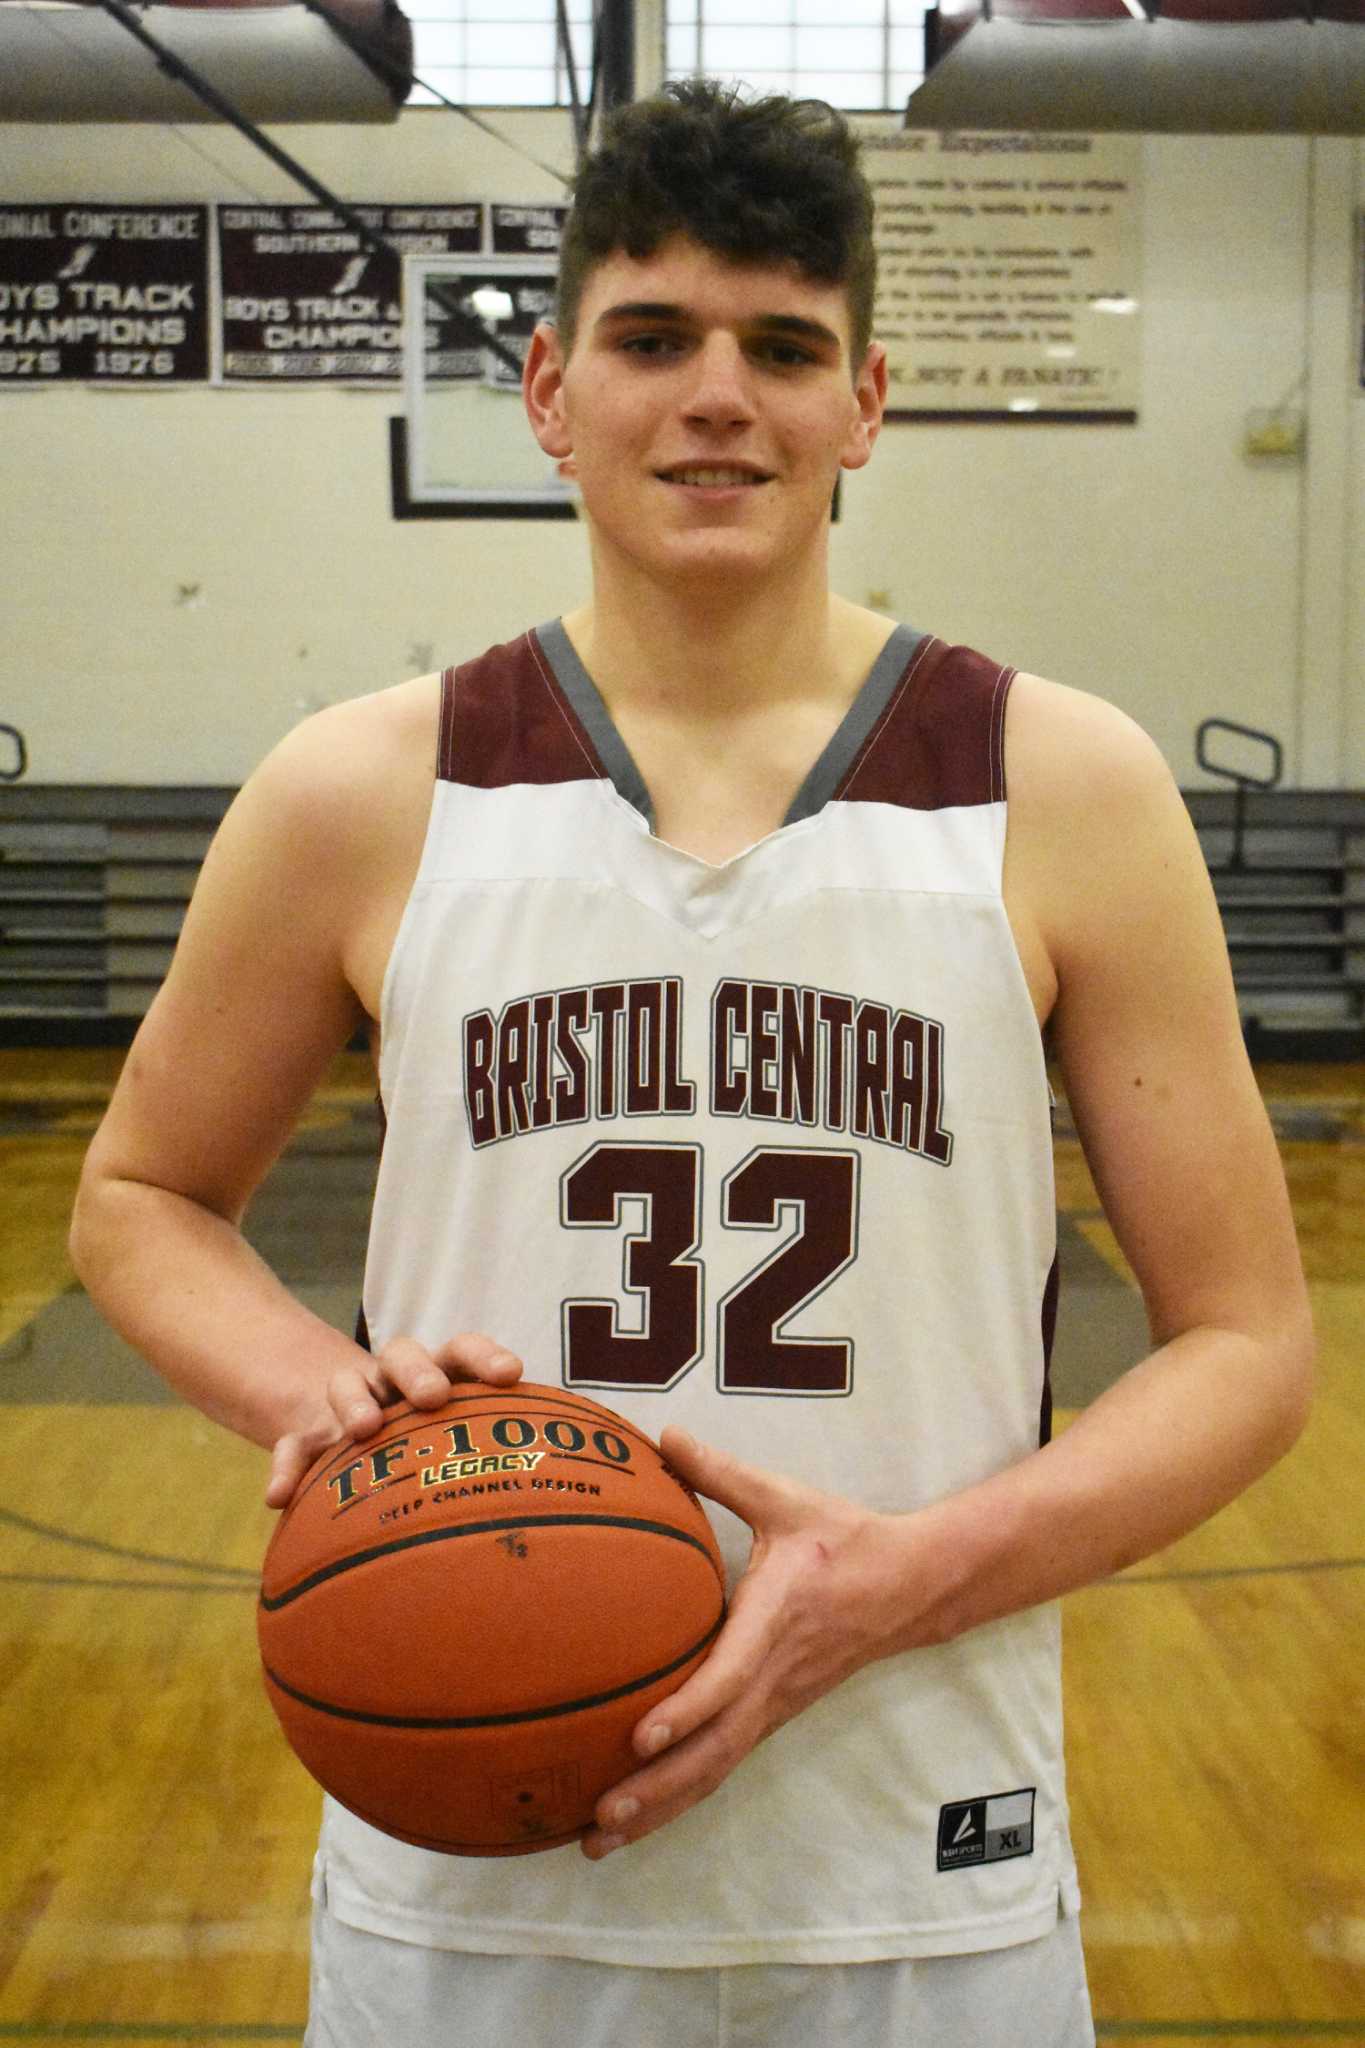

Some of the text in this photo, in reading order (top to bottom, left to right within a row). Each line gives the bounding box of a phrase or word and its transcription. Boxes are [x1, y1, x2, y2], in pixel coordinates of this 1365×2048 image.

[63, 211, 199, 239] CONFERENCE
[68, 283, 195, 311] TRACK
[294, 296, 379, 320] TRACK
[264, 325, 440, 349] CHAMPIOS
[462, 976, 954, 1167] BRISTOL CENTRAL
[559, 1140, 861, 1398] 32
[327, 1417, 631, 1506] TF-1000
[420, 1451, 546, 1489] LEGACY
[432, 1478, 523, 1504] CHANNEL
[531, 1477, 601, 1496] DESIGN
[1000, 1830, 1023, 1850] XL
